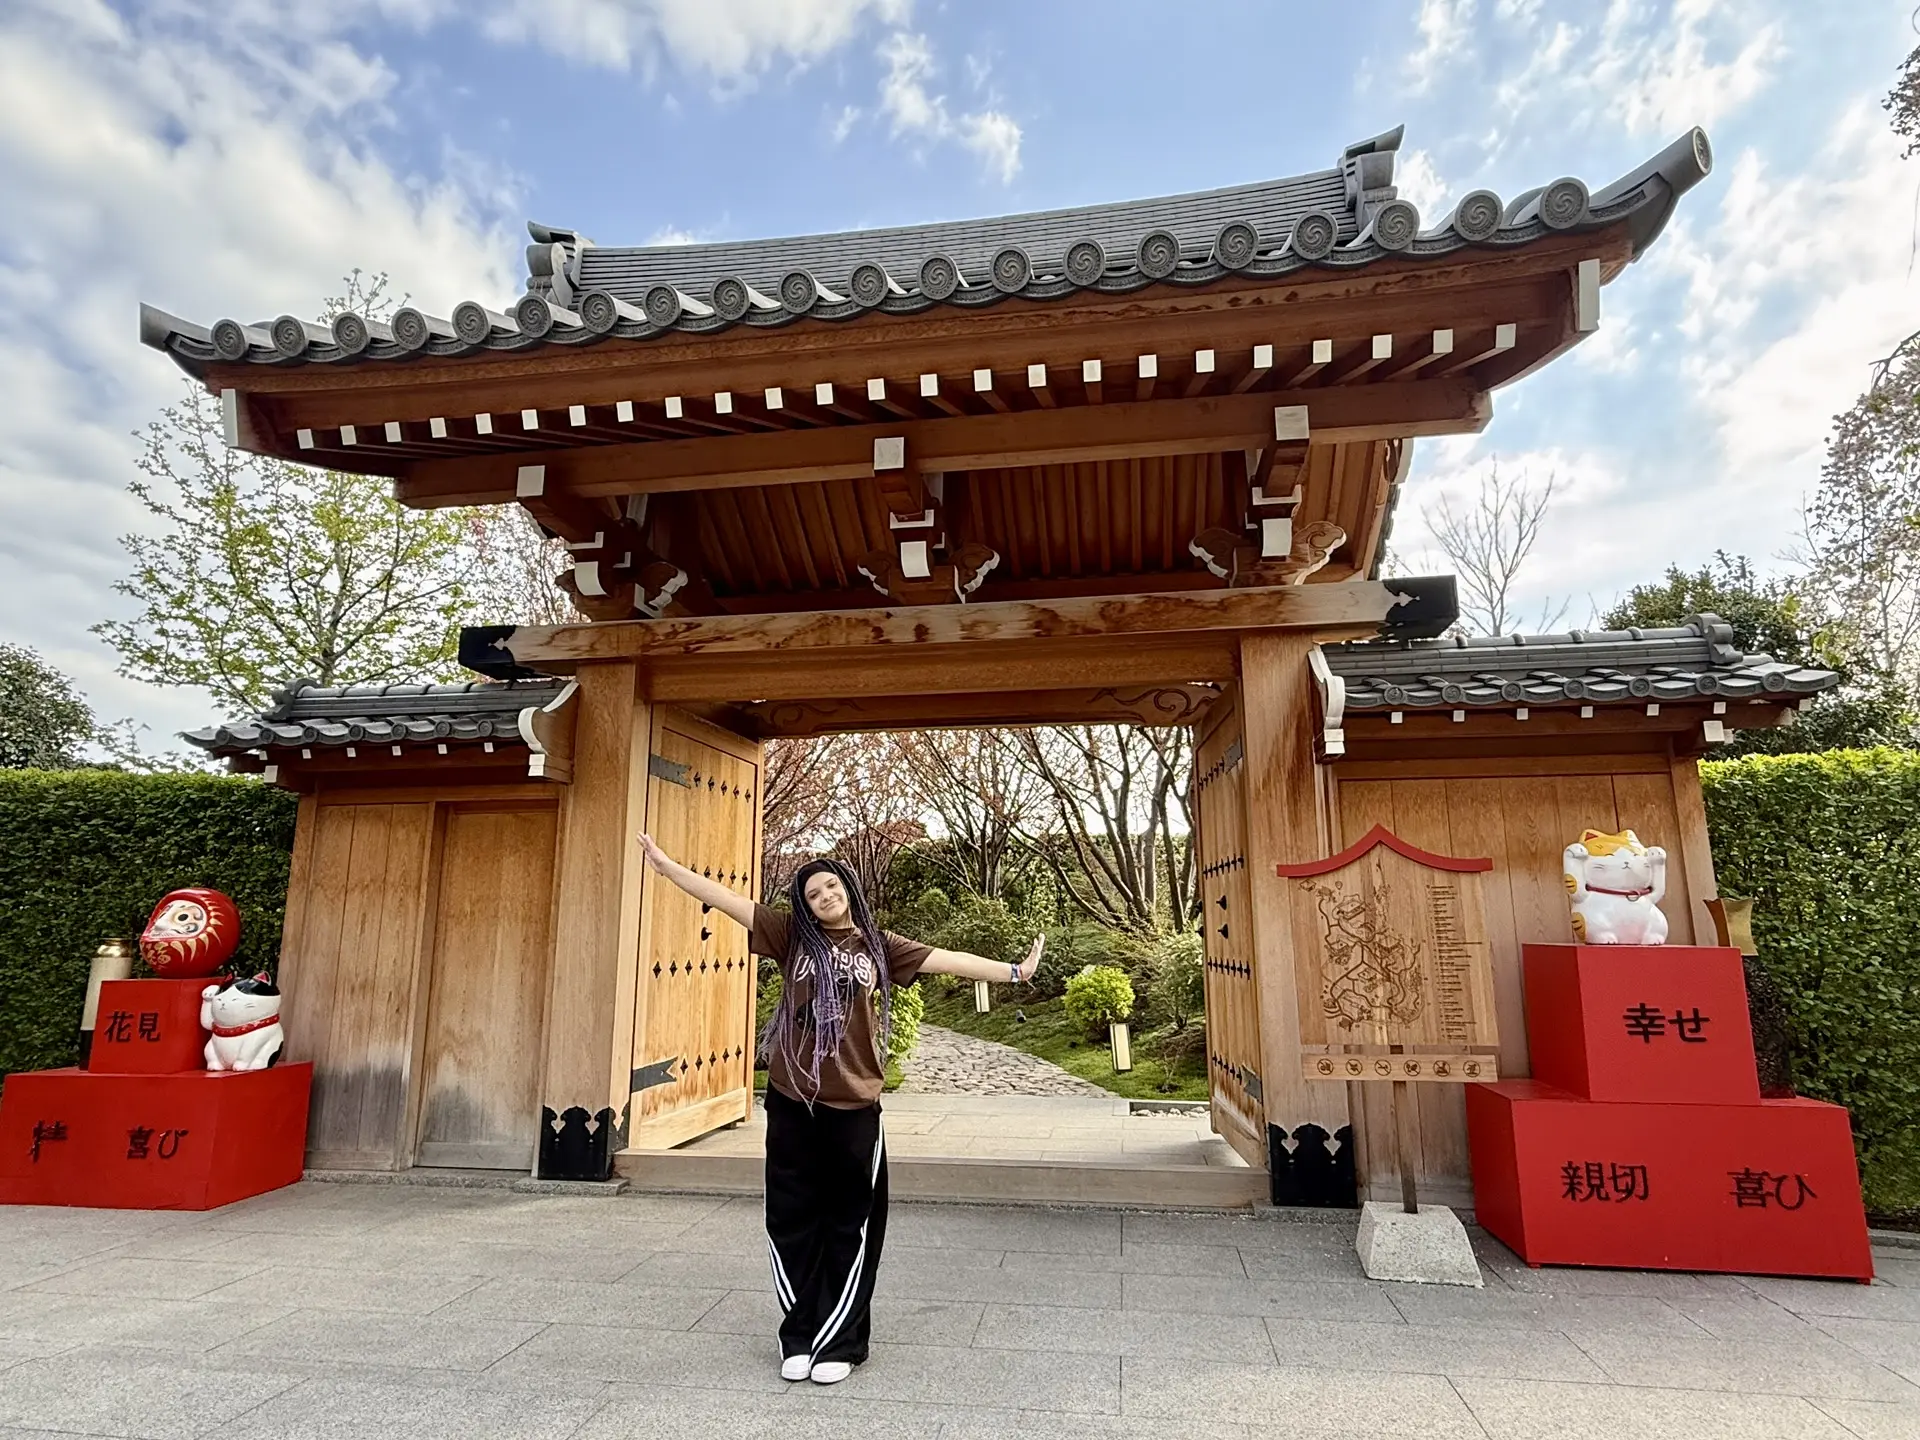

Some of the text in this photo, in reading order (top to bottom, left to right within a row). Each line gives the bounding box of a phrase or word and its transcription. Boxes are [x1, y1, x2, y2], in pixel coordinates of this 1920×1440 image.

[104, 1011, 161, 1043] 花見
[1623, 1002, 1711, 1043] 幸せ
[1561, 1160, 1649, 1203] 親切
